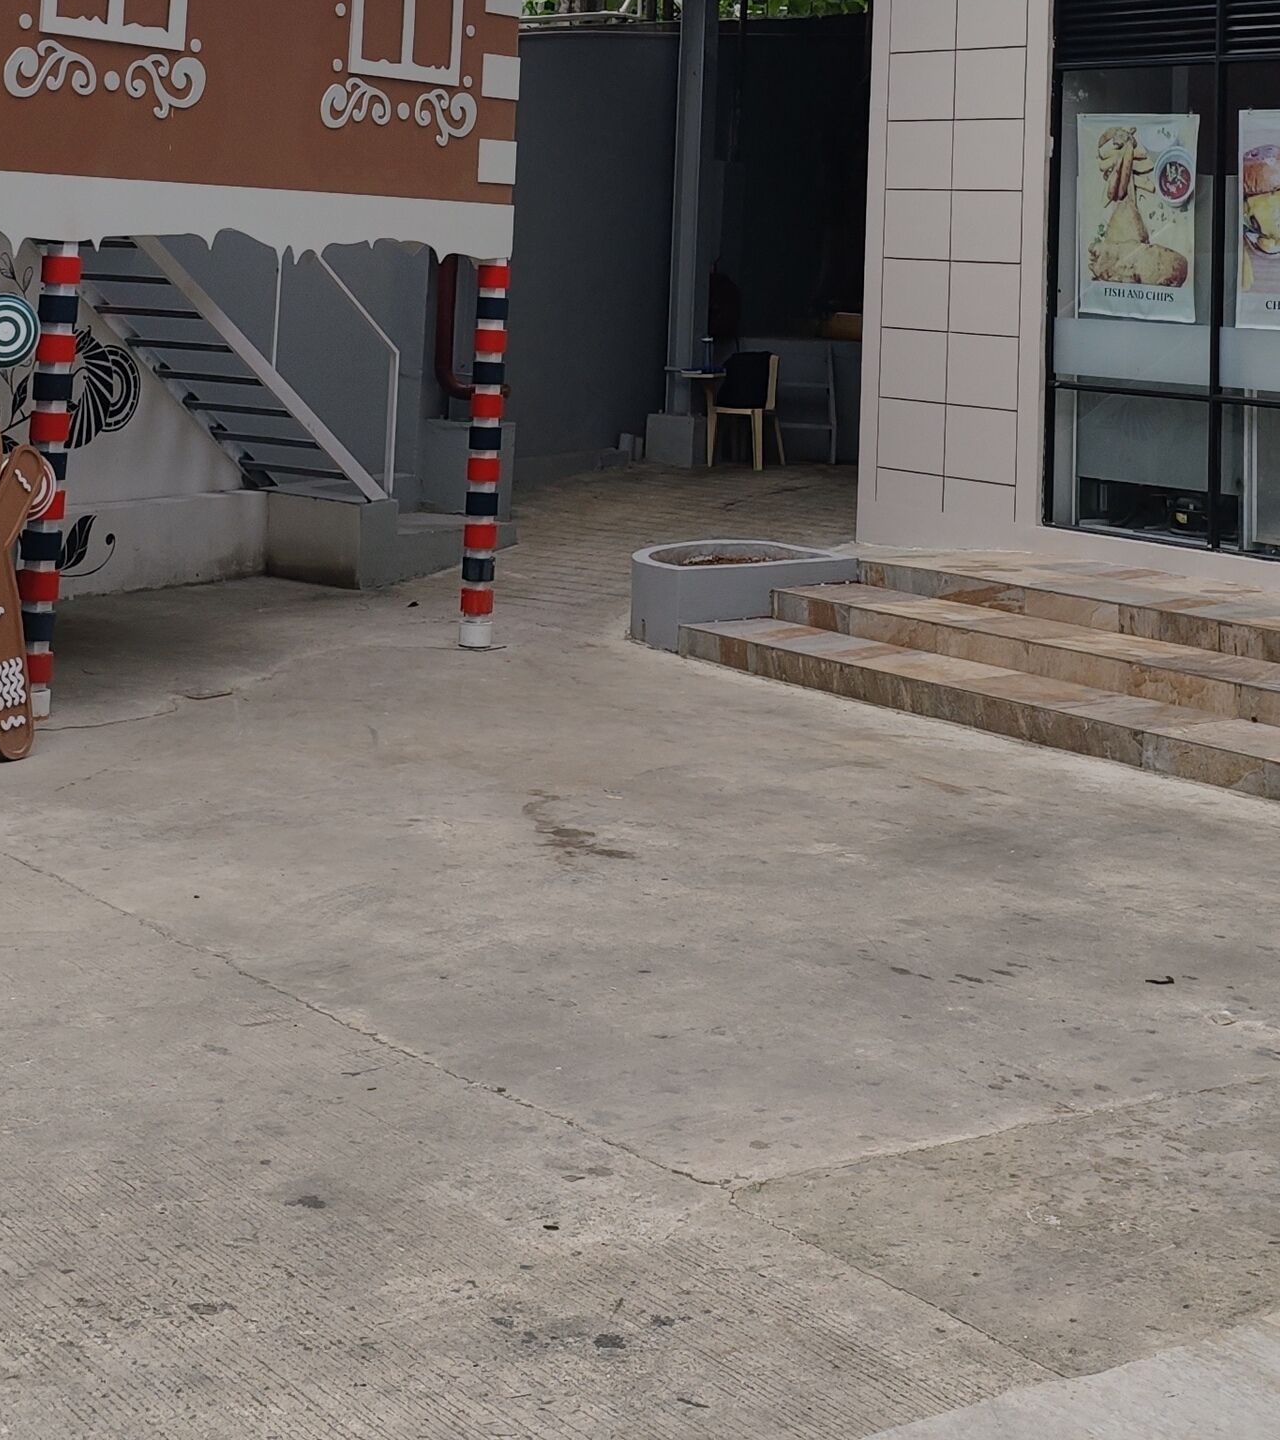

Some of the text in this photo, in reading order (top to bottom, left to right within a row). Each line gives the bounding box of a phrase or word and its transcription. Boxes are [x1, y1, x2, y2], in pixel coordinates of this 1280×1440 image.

[1104, 287, 1175, 302] FISH AND CHIPS
